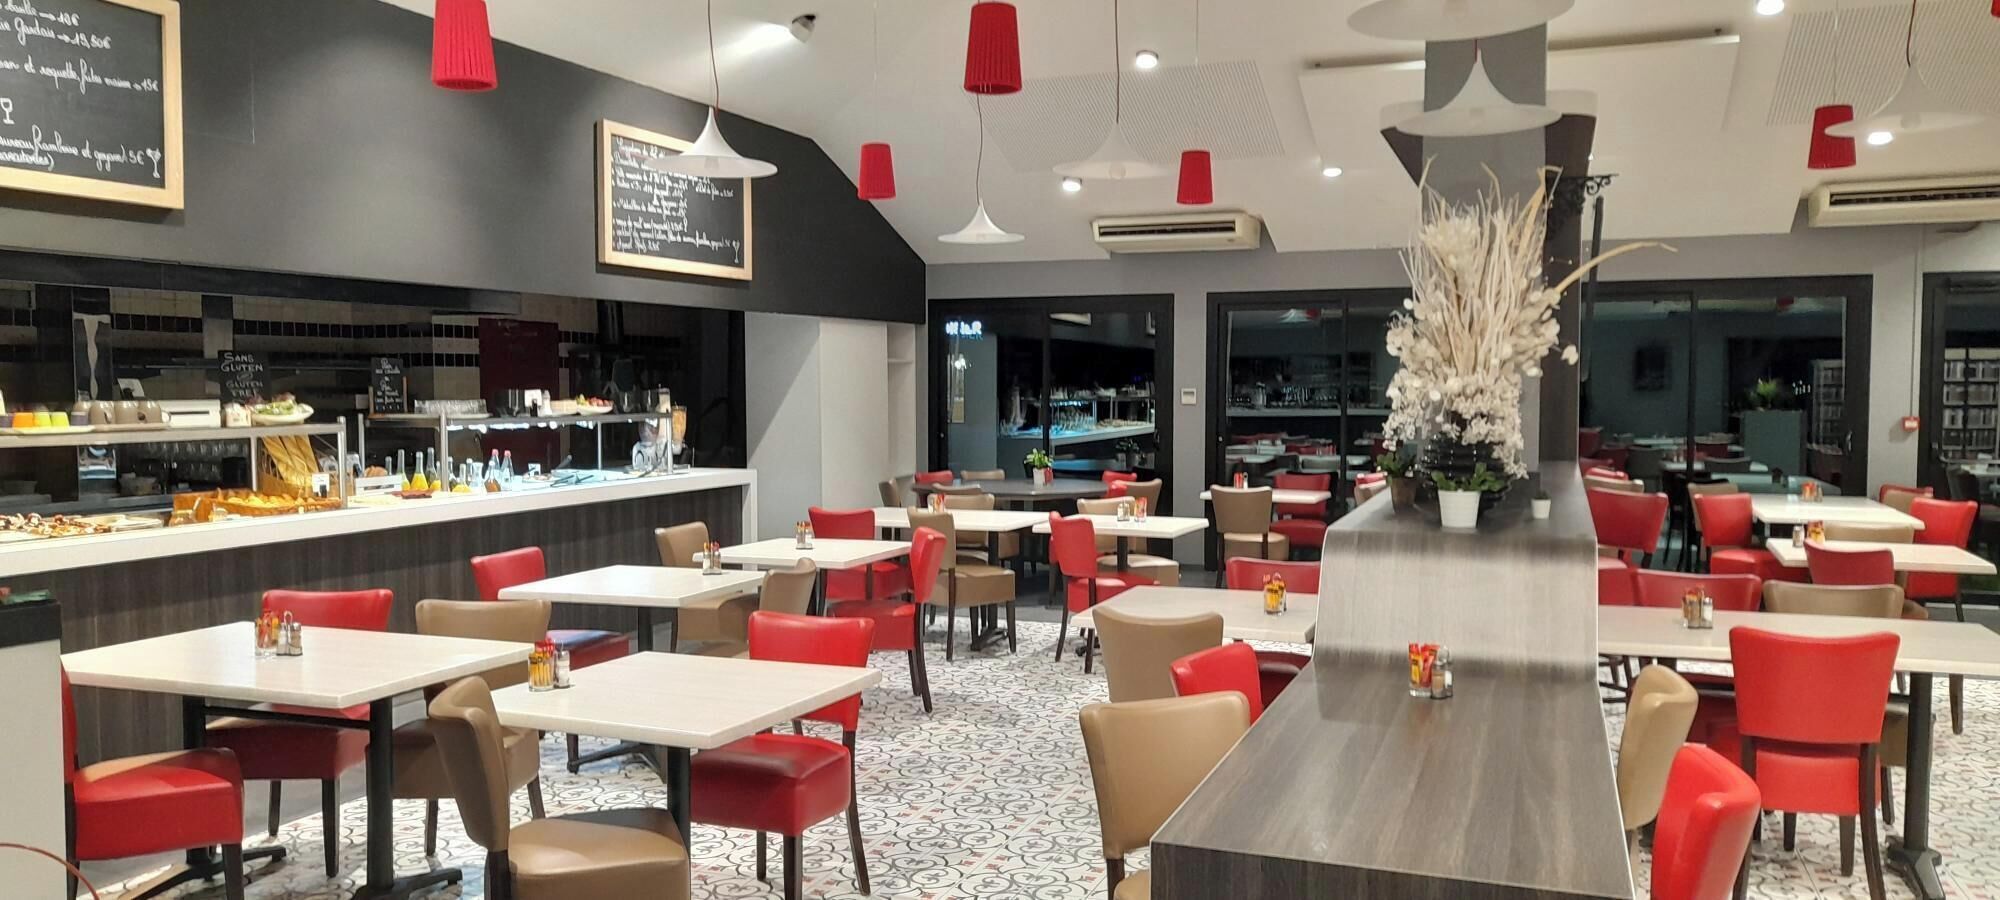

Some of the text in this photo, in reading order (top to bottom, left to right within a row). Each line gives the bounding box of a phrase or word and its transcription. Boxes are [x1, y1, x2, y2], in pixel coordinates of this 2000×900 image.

[24, 54, 36, 74] et
[81, 138, 93, 159] et
[220, 362, 264, 372] GLUTEN
[225, 380, 264, 389] GLUTEN
